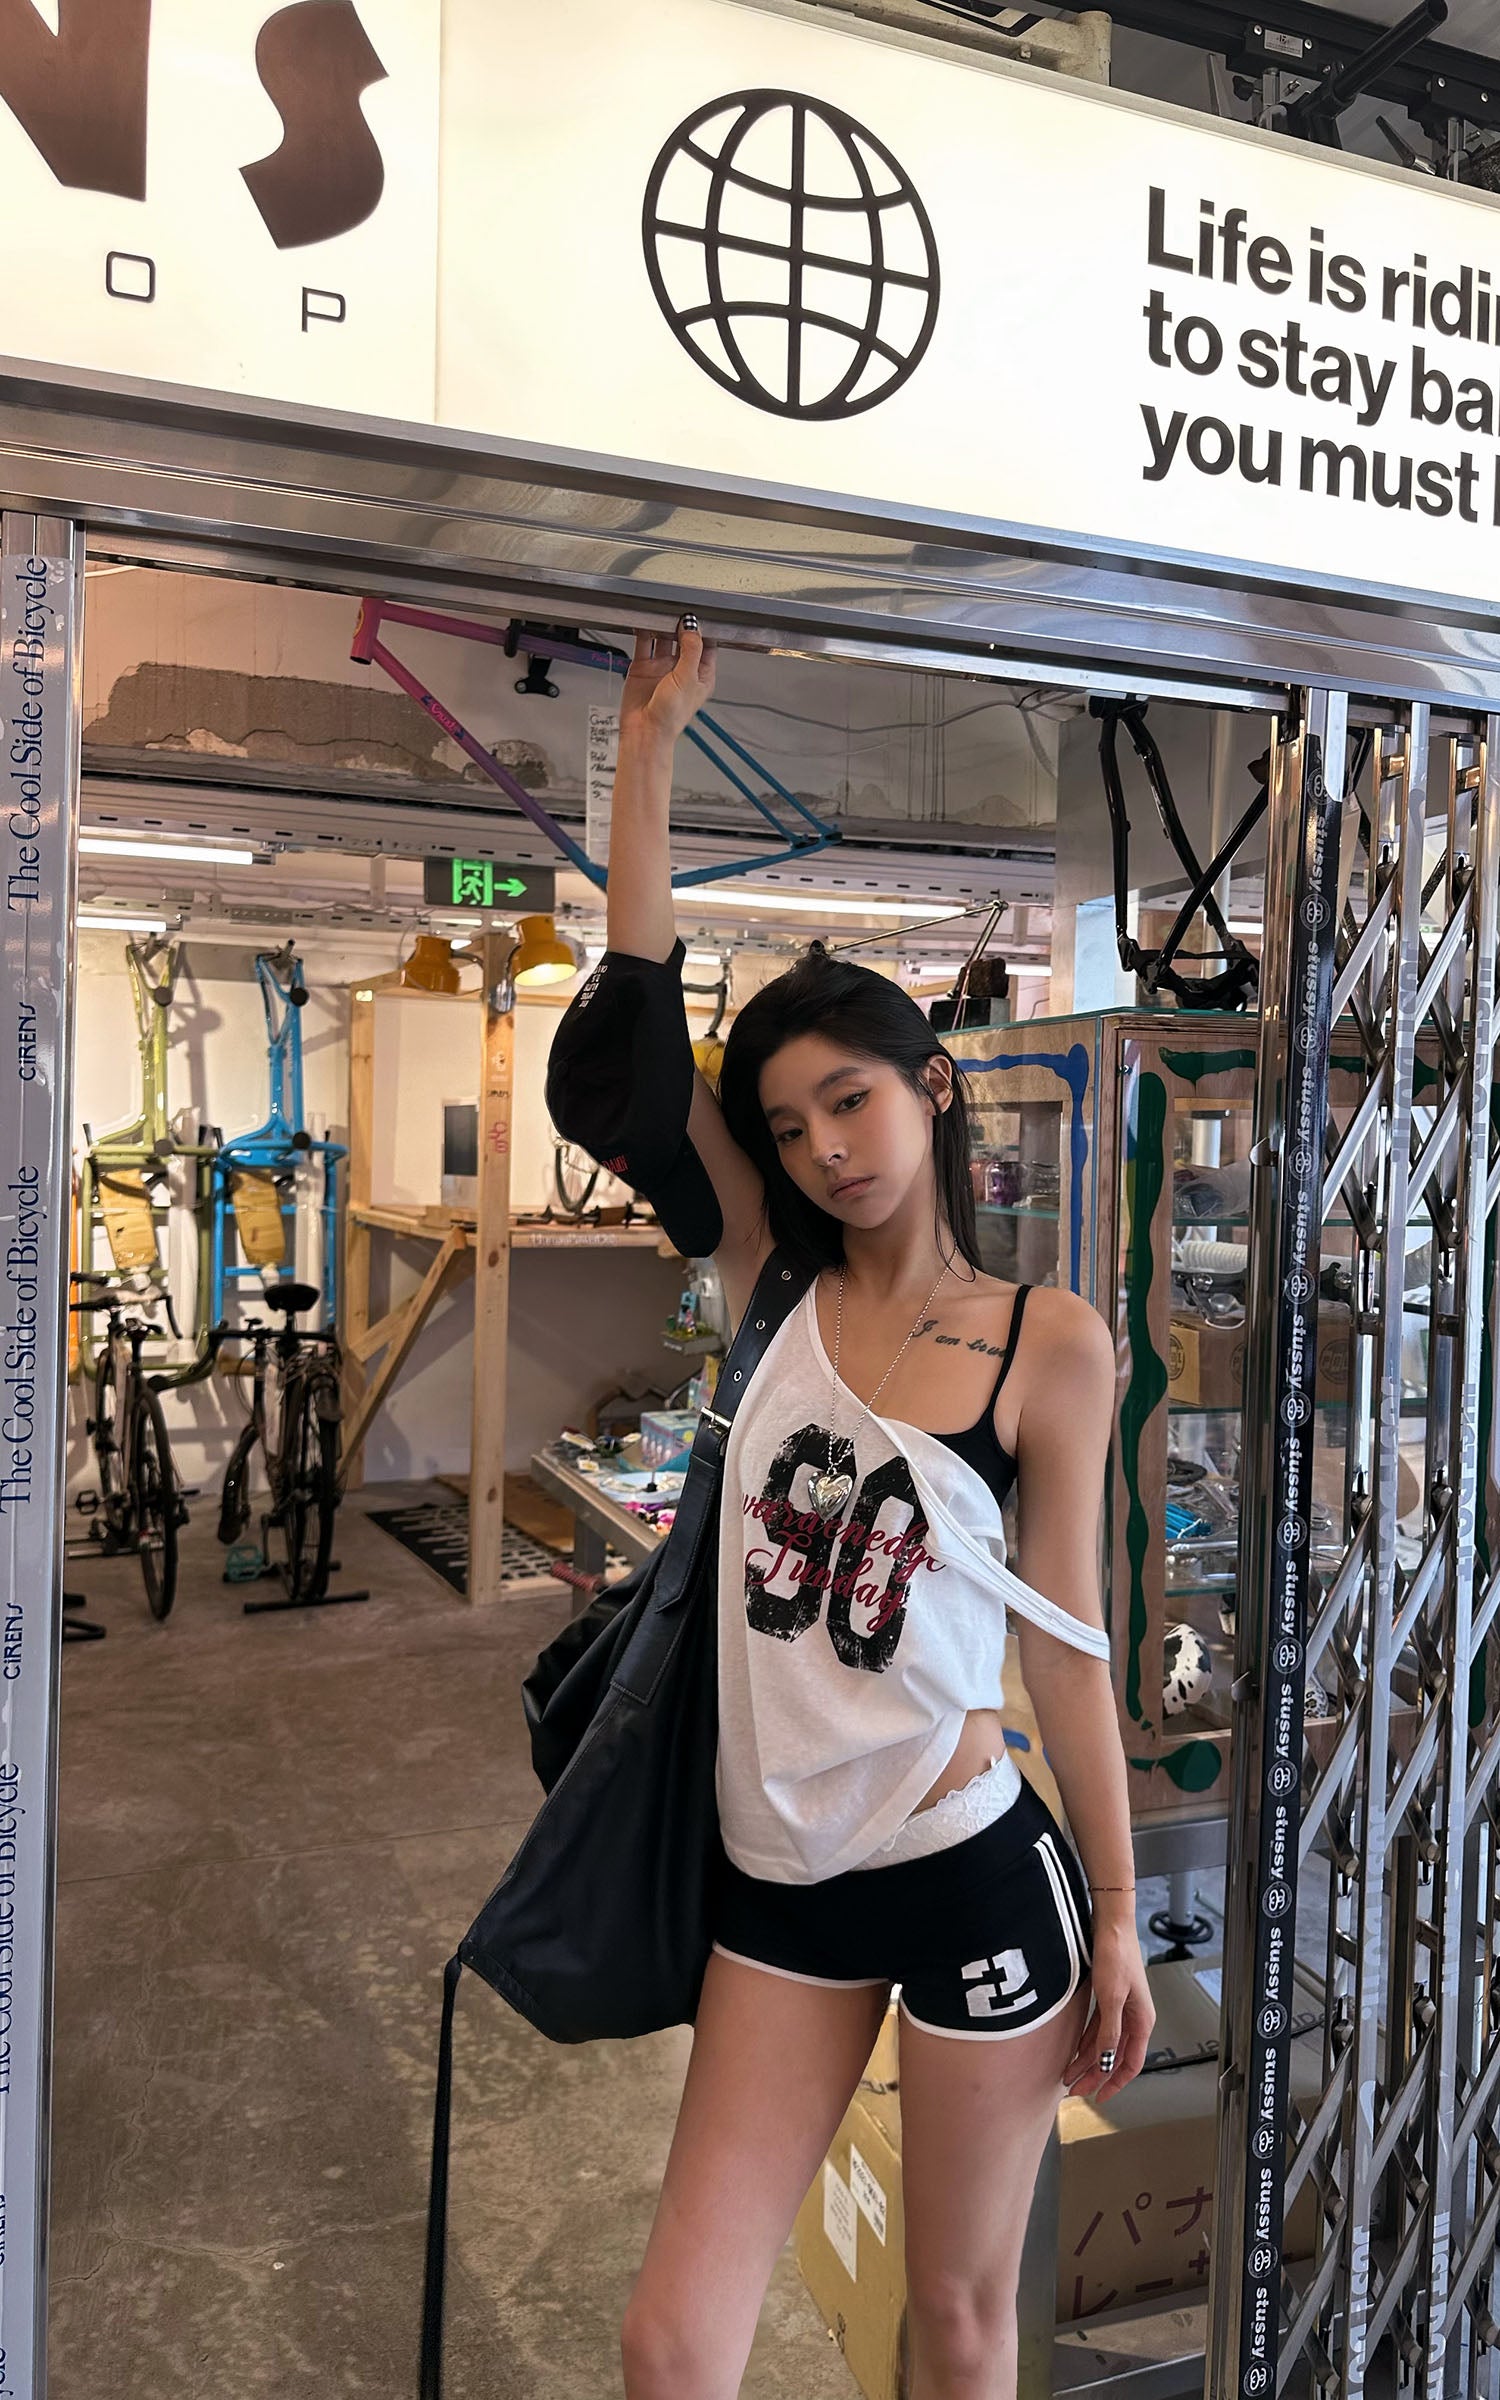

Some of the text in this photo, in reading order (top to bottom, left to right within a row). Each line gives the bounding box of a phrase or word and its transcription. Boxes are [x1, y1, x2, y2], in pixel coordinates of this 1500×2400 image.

[1146, 186, 1292, 296] Life
[1308, 227, 1368, 314] is
[1143, 289, 1224, 377] to
[1237, 320, 1397, 426] stay
[1139, 403, 1285, 486] you
[1299, 436, 1480, 523] must
[8, 558, 55, 912] The Cool Side of Bicycle
[1308, 815, 1328, 893] stussy
[1302, 941, 1321, 1018] stussy
[1296, 1067, 1316, 1144] stussy
[1290, 1190, 1309, 1267] stussy
[0, 1165, 48, 1514] The Cool Side of Bicycle
[909, 1319, 939, 1338] I
[935, 1335, 961, 1346] am
[1287, 1314, 1307, 1390] stussy
[1284, 1437, 1303, 1512] stussy
[1280, 1560, 1299, 1635] stussy
[1276, 1683, 1294, 1758] stussy
[1270, 1805, 1289, 1880] stussy
[1264, 1927, 1284, 2001] stussy
[1260, 2048, 1278, 2121] stussy
[1256, 2168, 1273, 2242] stussy
[1251, 2287, 1270, 2361] stussy
